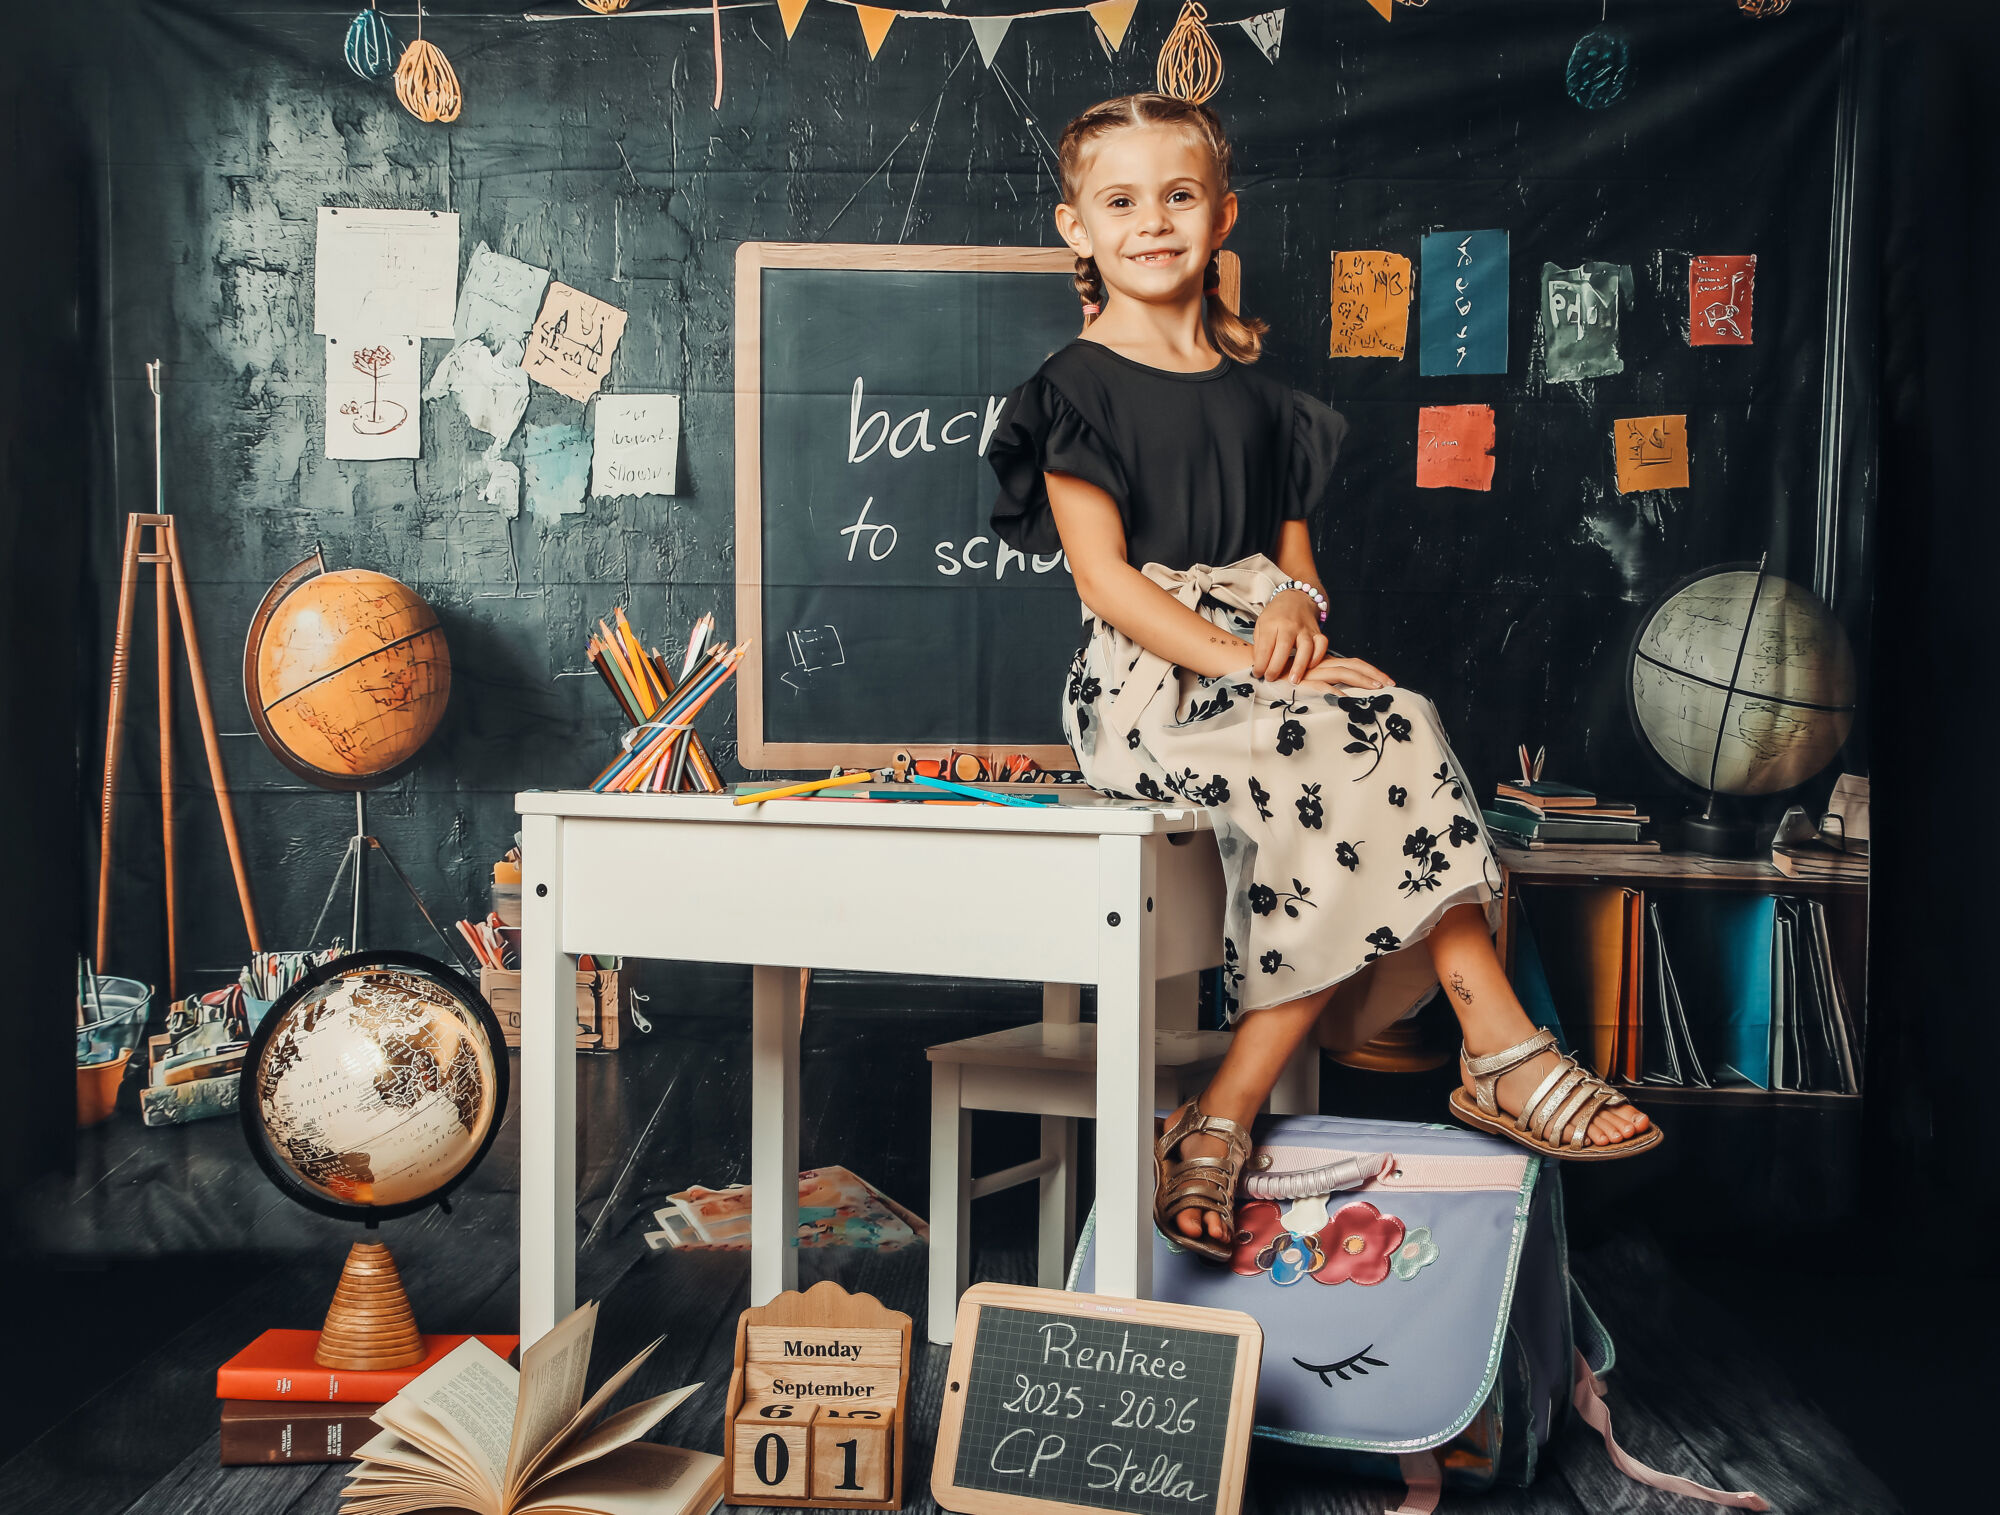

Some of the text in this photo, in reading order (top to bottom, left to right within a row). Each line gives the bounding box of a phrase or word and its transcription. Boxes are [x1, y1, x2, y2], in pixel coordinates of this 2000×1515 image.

[840, 496, 898, 561] to
[784, 1340, 862, 1361] Monday
[1038, 1322, 1187, 1380] Rentrée
[773, 1379, 875, 1399] September
[991, 1428, 1208, 1502] CP Stella
